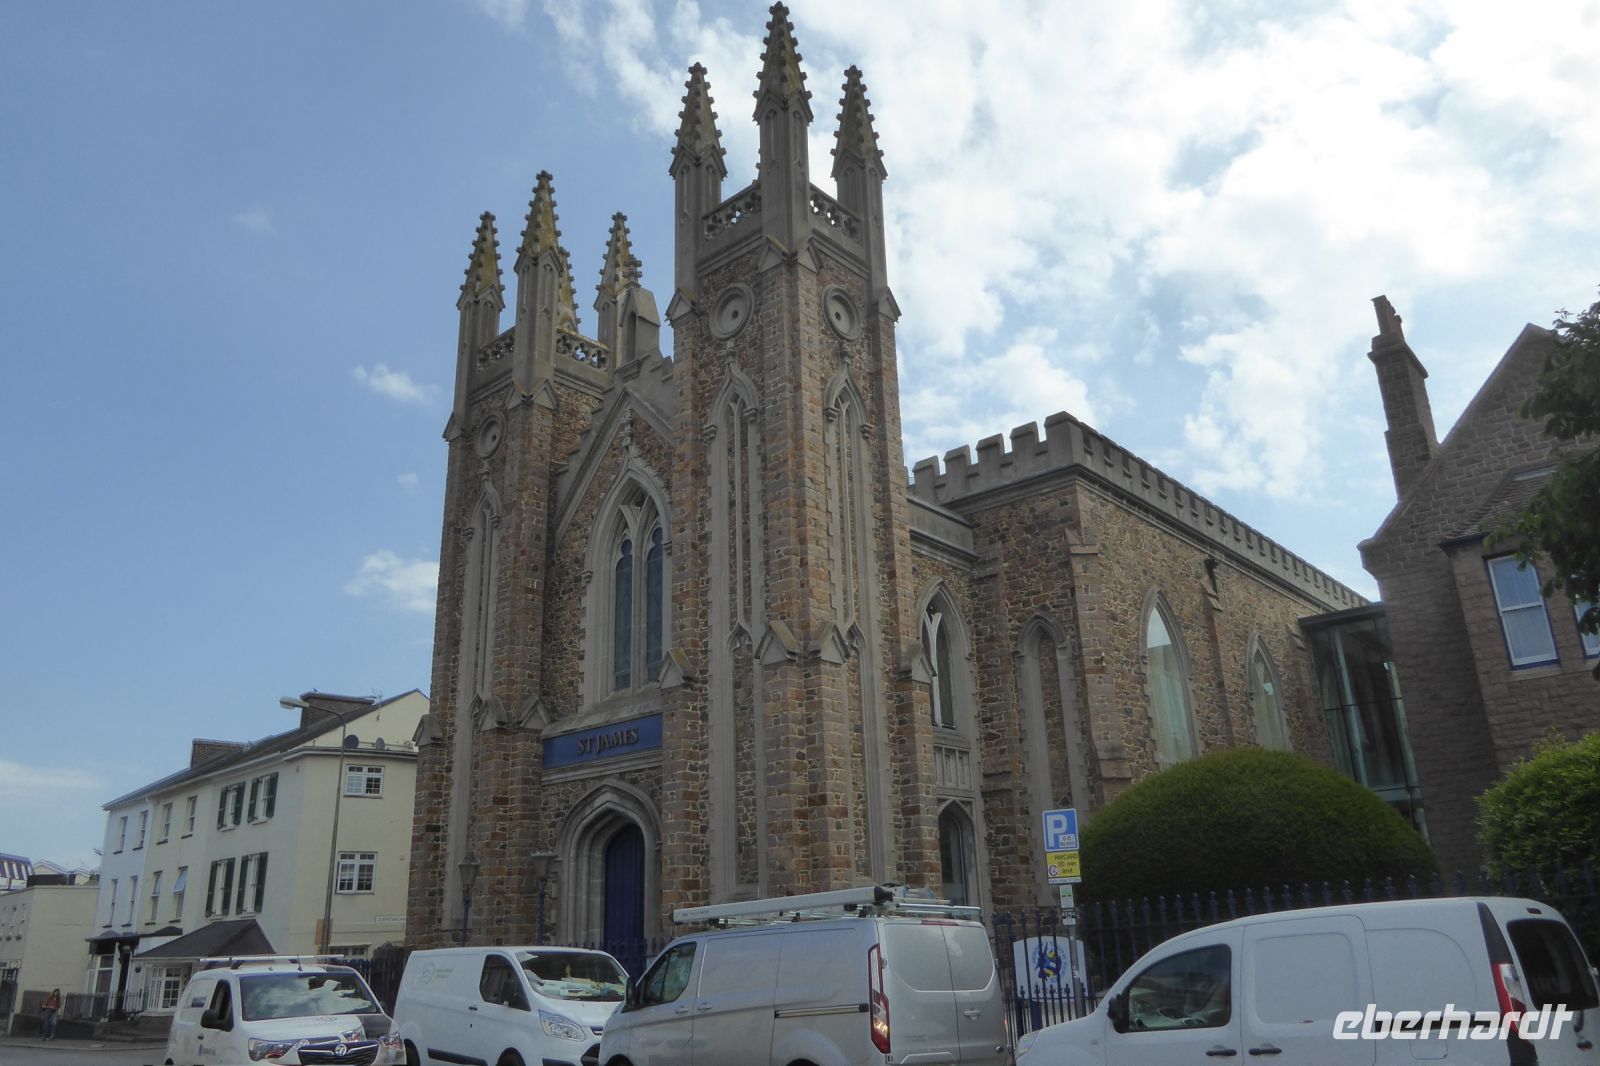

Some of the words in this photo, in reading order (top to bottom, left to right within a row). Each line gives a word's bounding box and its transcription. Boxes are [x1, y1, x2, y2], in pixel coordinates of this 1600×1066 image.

[577, 737, 593, 755] ST
[596, 728, 639, 753] JAMES
[1046, 815, 1068, 848] P
